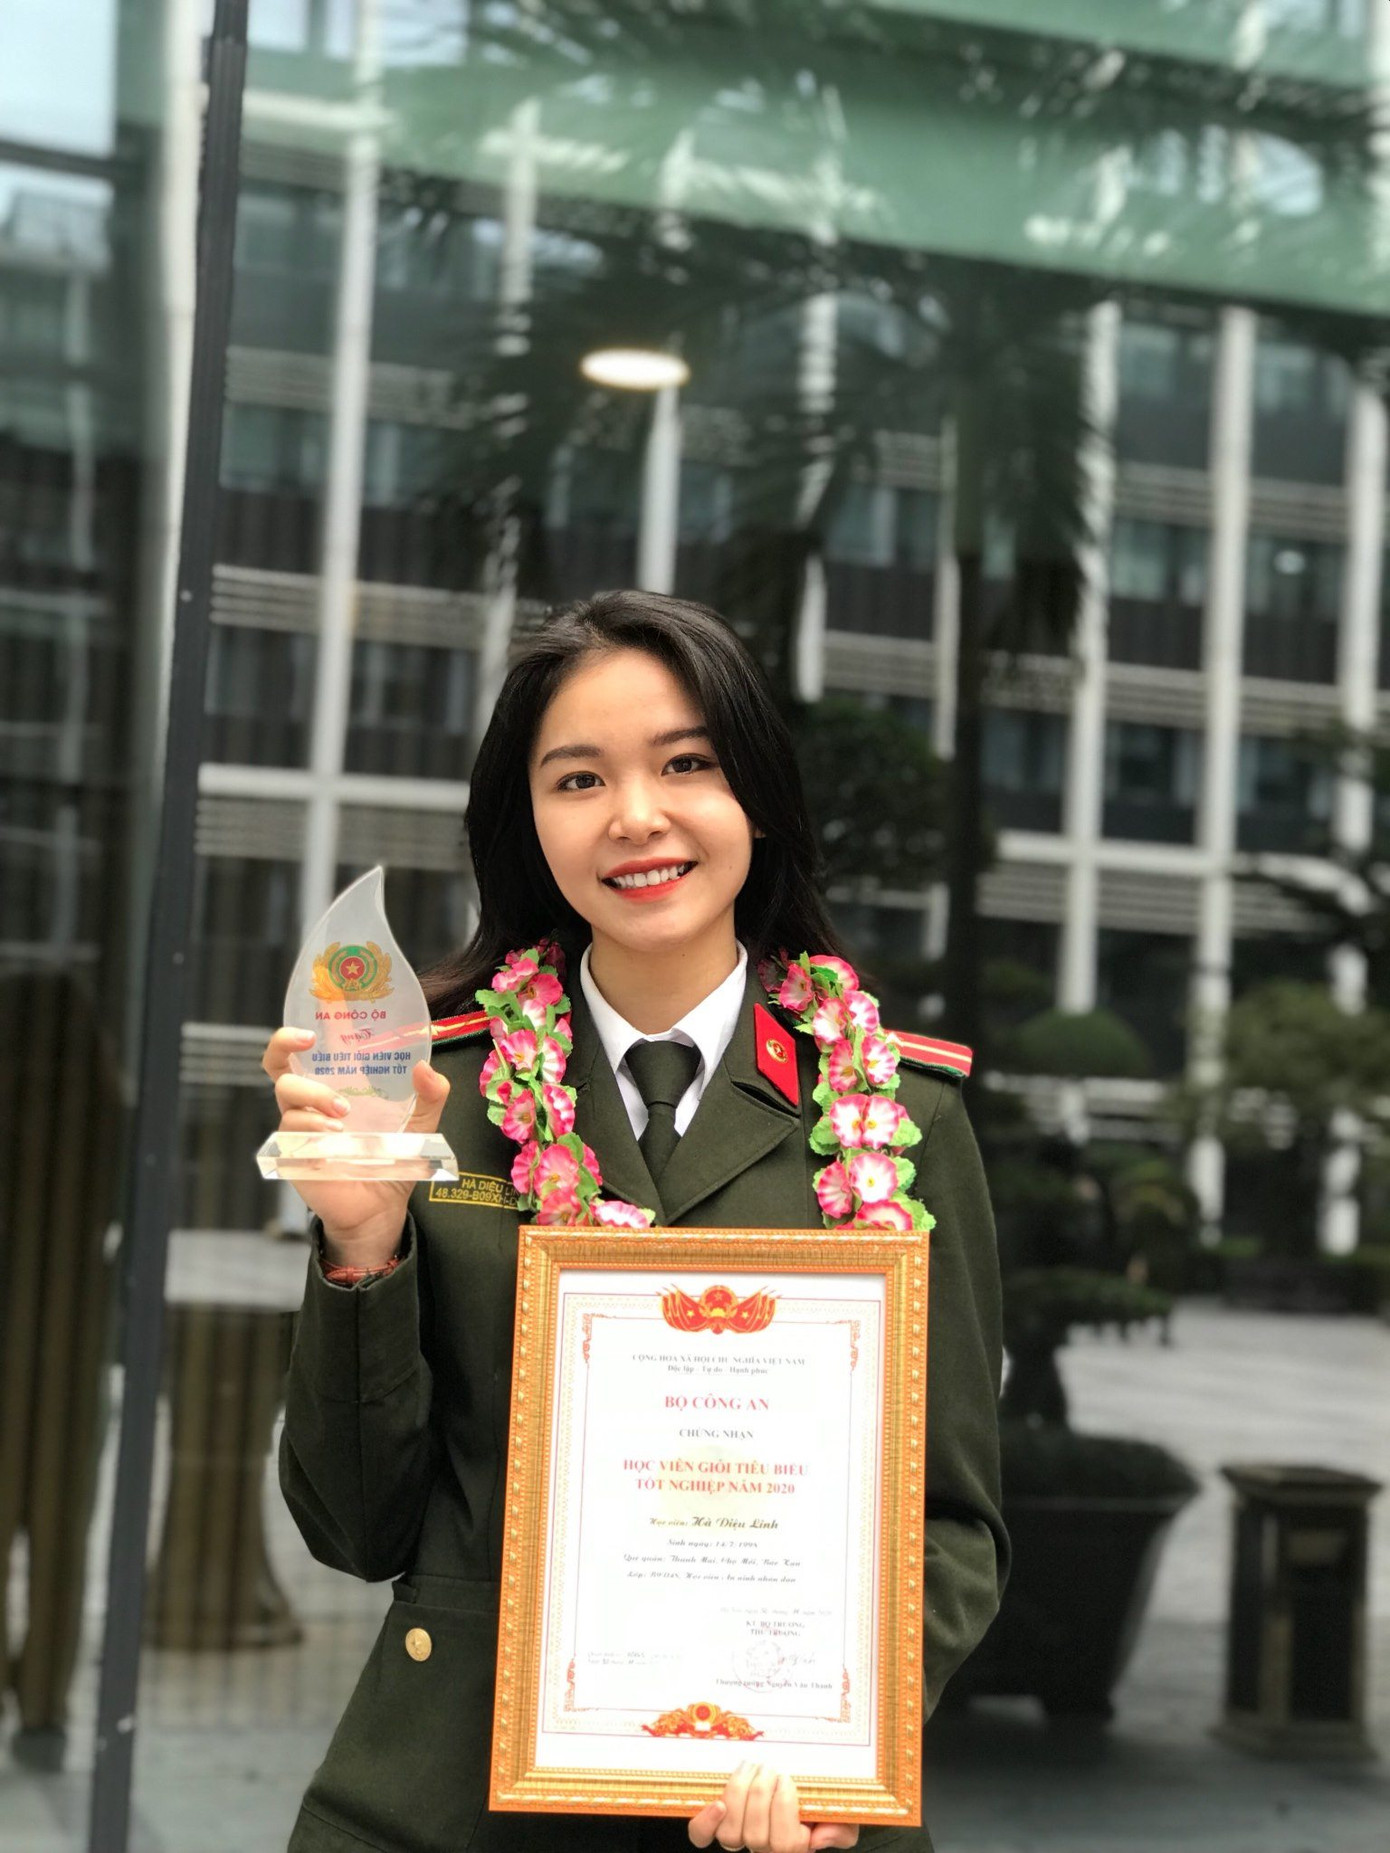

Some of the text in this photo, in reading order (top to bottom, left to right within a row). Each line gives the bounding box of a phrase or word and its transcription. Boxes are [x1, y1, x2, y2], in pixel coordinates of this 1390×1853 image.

[461, 1178, 476, 1190] HÀ
[478, 1180, 504, 1194] DIỆU
[692, 1393, 741, 1410] CÔNG
[746, 1398, 770, 1411] AN
[623, 1459, 655, 1473] HỌC
[767, 1482, 796, 1494] 2020
